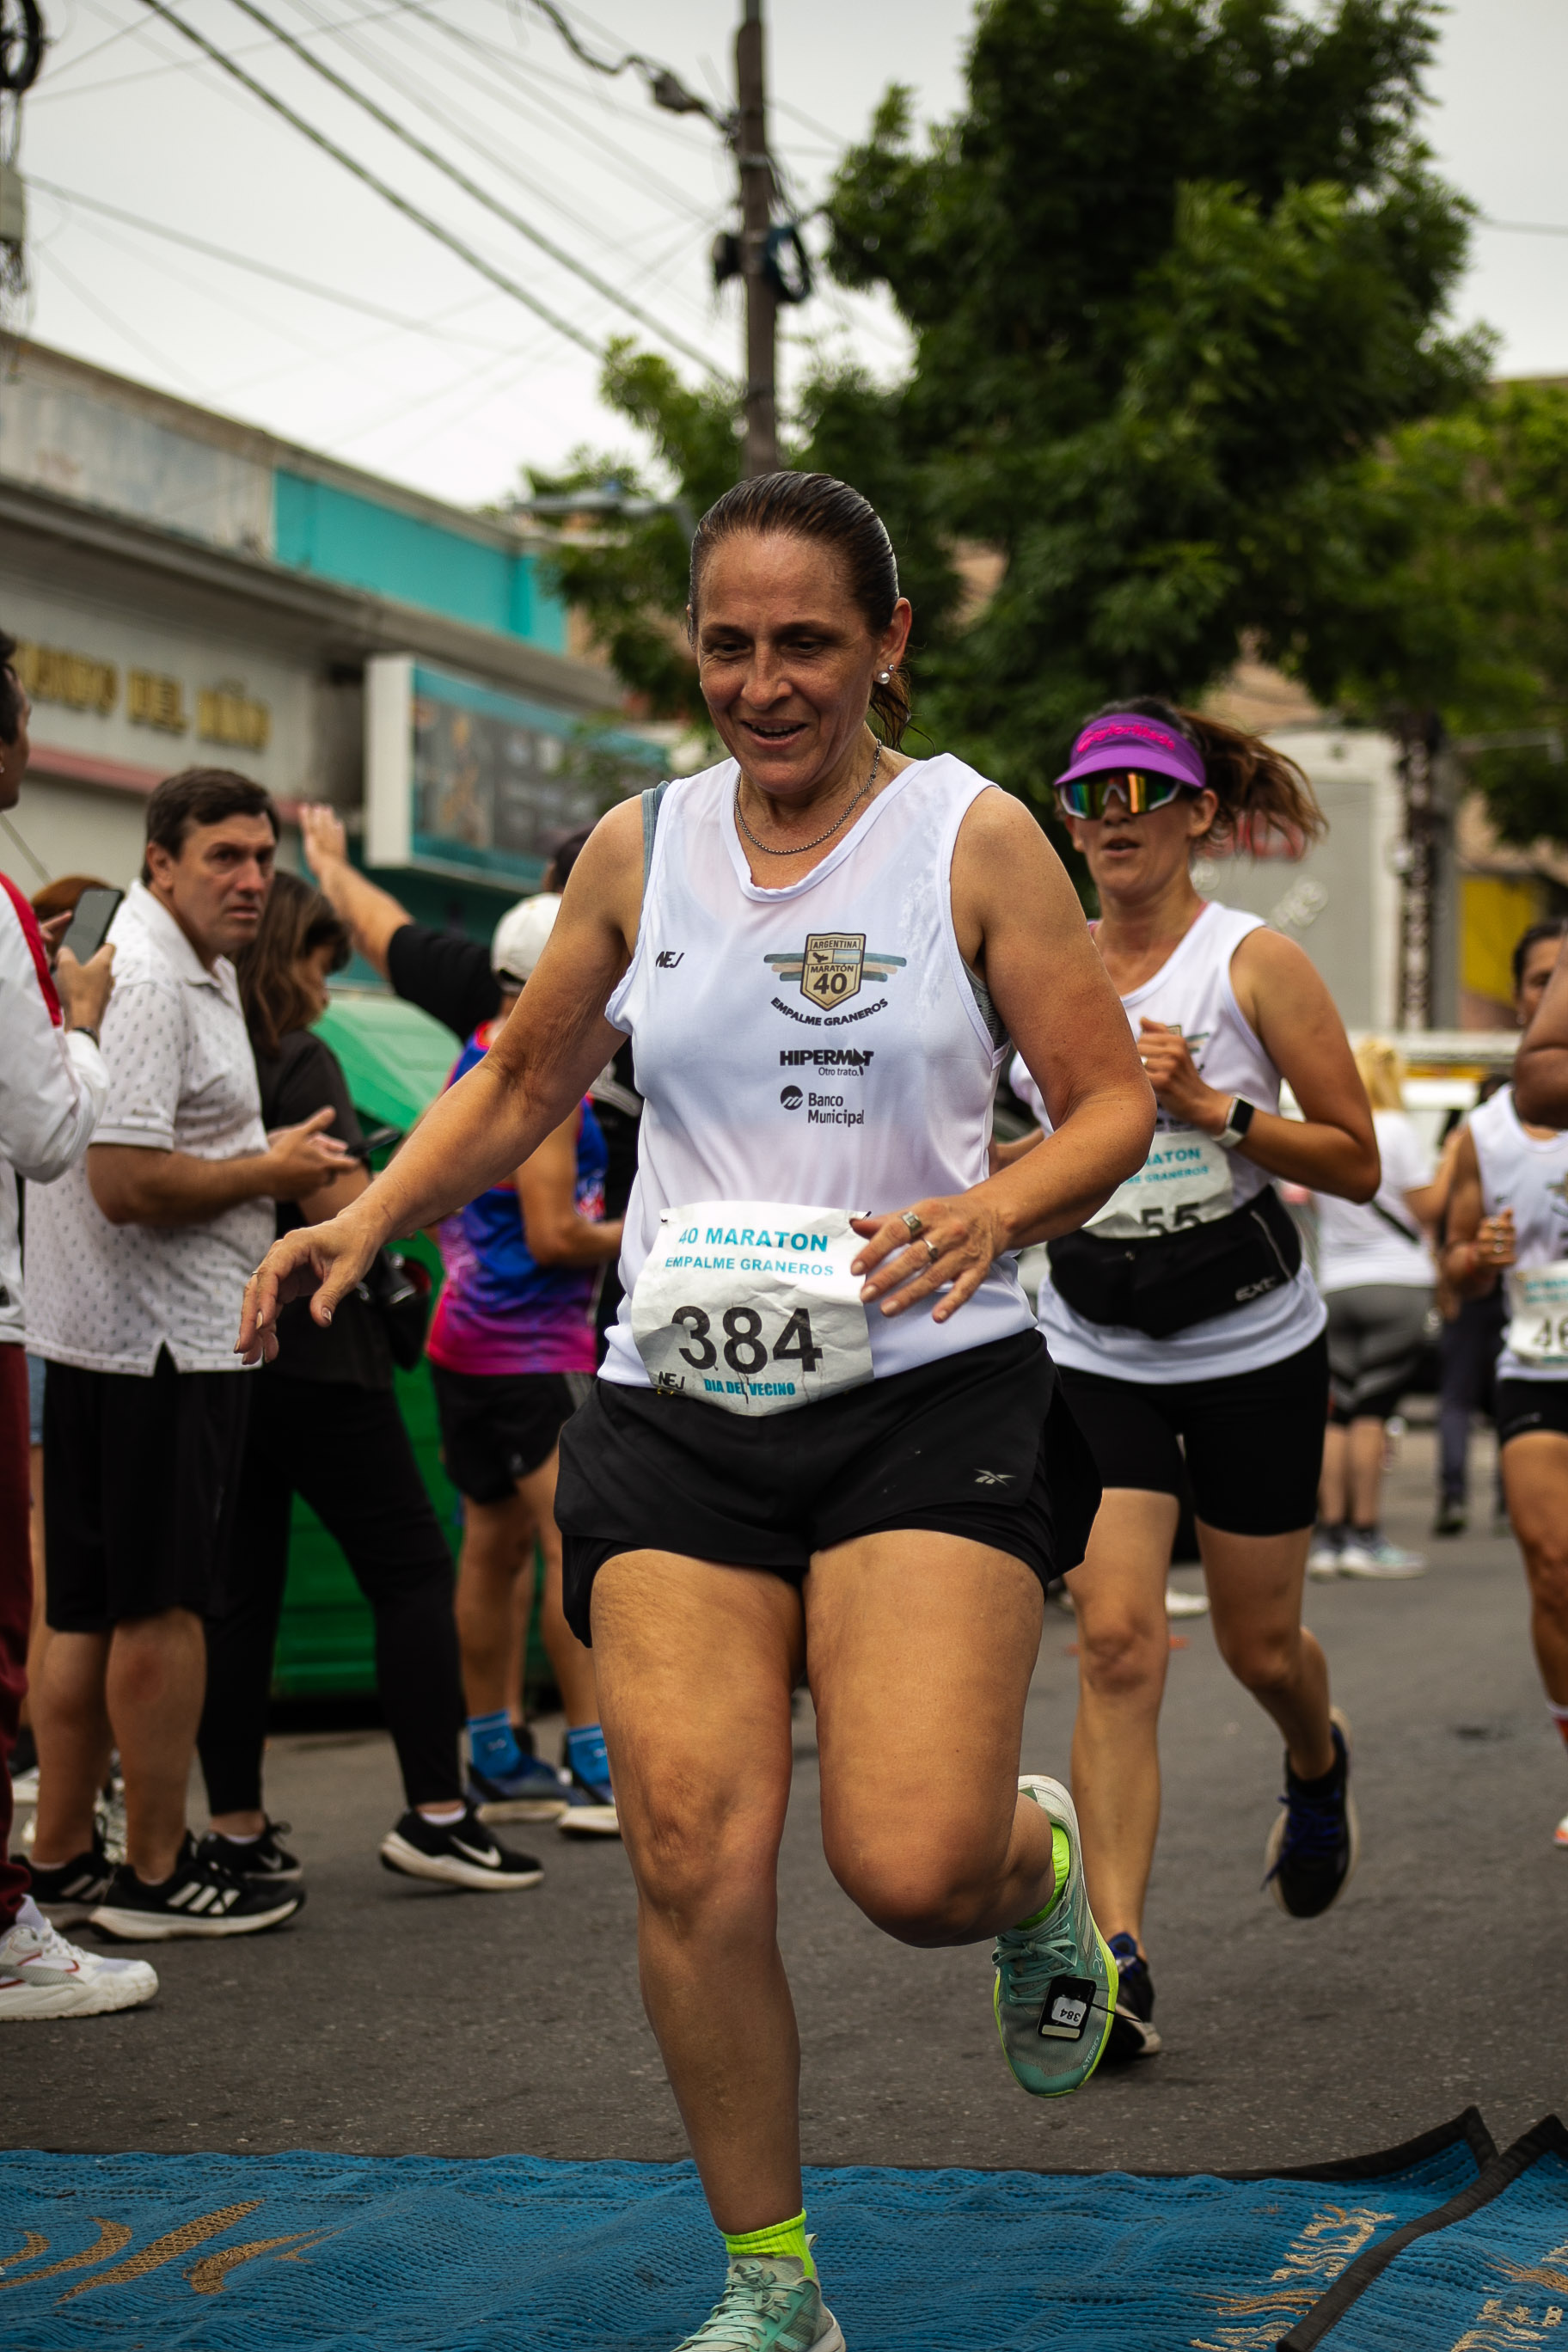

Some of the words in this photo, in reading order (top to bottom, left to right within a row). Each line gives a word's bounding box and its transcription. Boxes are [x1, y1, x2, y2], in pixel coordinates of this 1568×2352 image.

[812, 940, 858, 950] ARGENTINA
[810, 963, 854, 974] MARATÓN
[812, 973, 848, 995] 40
[770, 996, 823, 1026] EMPALME
[824, 998, 889, 1026] GRANEROS
[818, 1067, 836, 1076] Otro
[808, 1092, 844, 1107] Banco
[807, 1109, 864, 1127] Municipal
[678, 1228, 699, 1245] 40
[705, 1228, 829, 1253] MARATON
[665, 1257, 735, 1271] EMPALME
[740, 1259, 834, 1277] GRANEROS
[671, 1305, 824, 1375] 384
[658, 1370, 686, 1390] NEJ
[704, 1379, 726, 1394] DIA
[726, 1381, 747, 1395] DEL
[749, 1381, 796, 1396] VECINO
[1060, 2007, 1081, 2022] 384
[1085, 2035, 1100, 2063] TERREX
